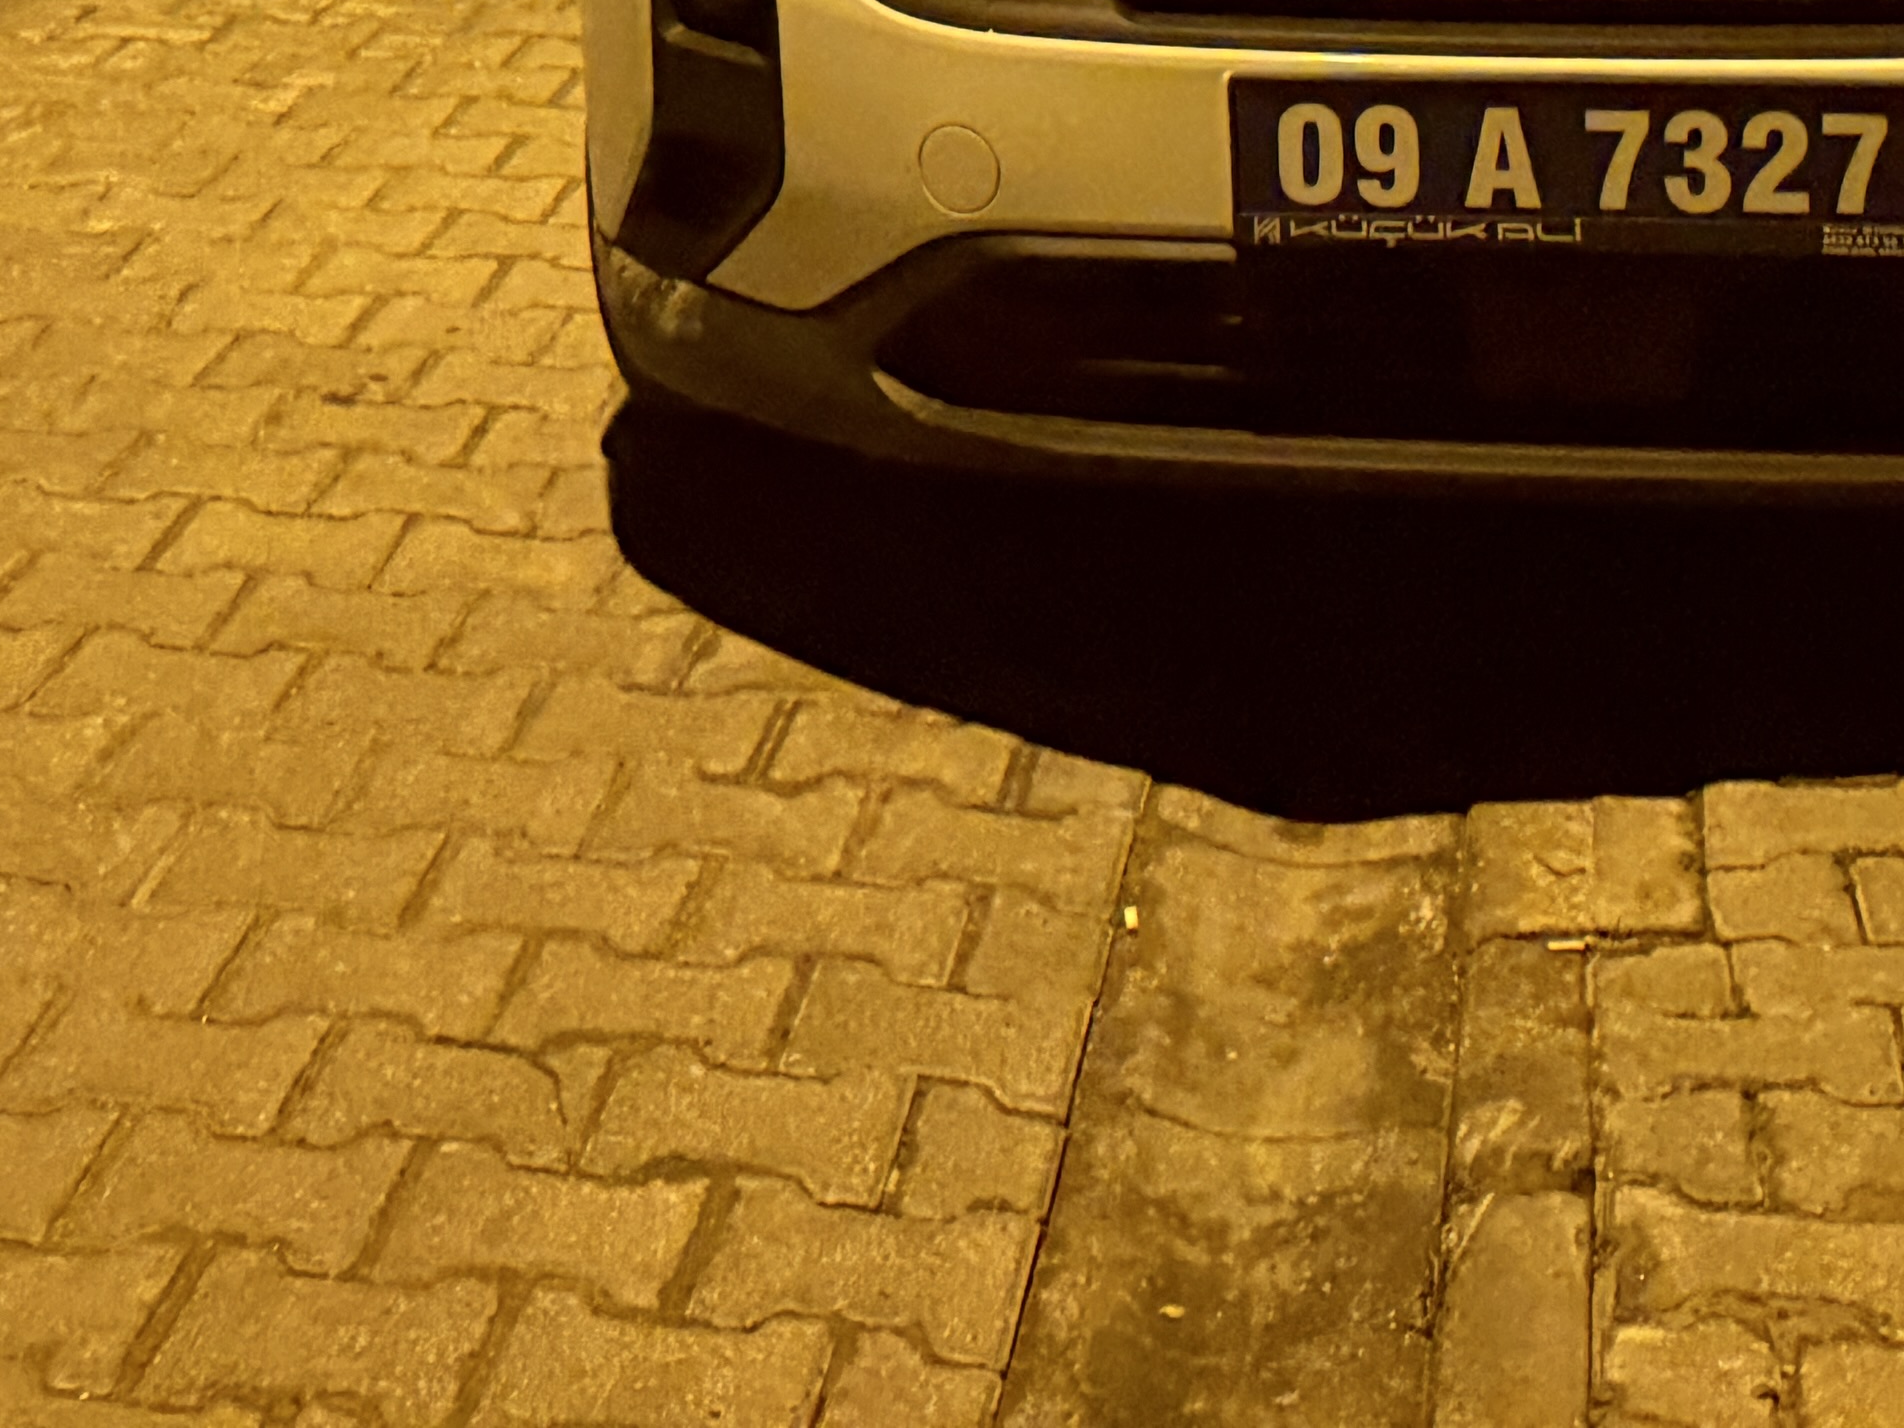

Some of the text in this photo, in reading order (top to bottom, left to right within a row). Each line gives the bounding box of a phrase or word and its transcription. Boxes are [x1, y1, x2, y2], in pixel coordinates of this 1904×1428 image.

[1278, 104, 1887, 214] 09 A 7327
